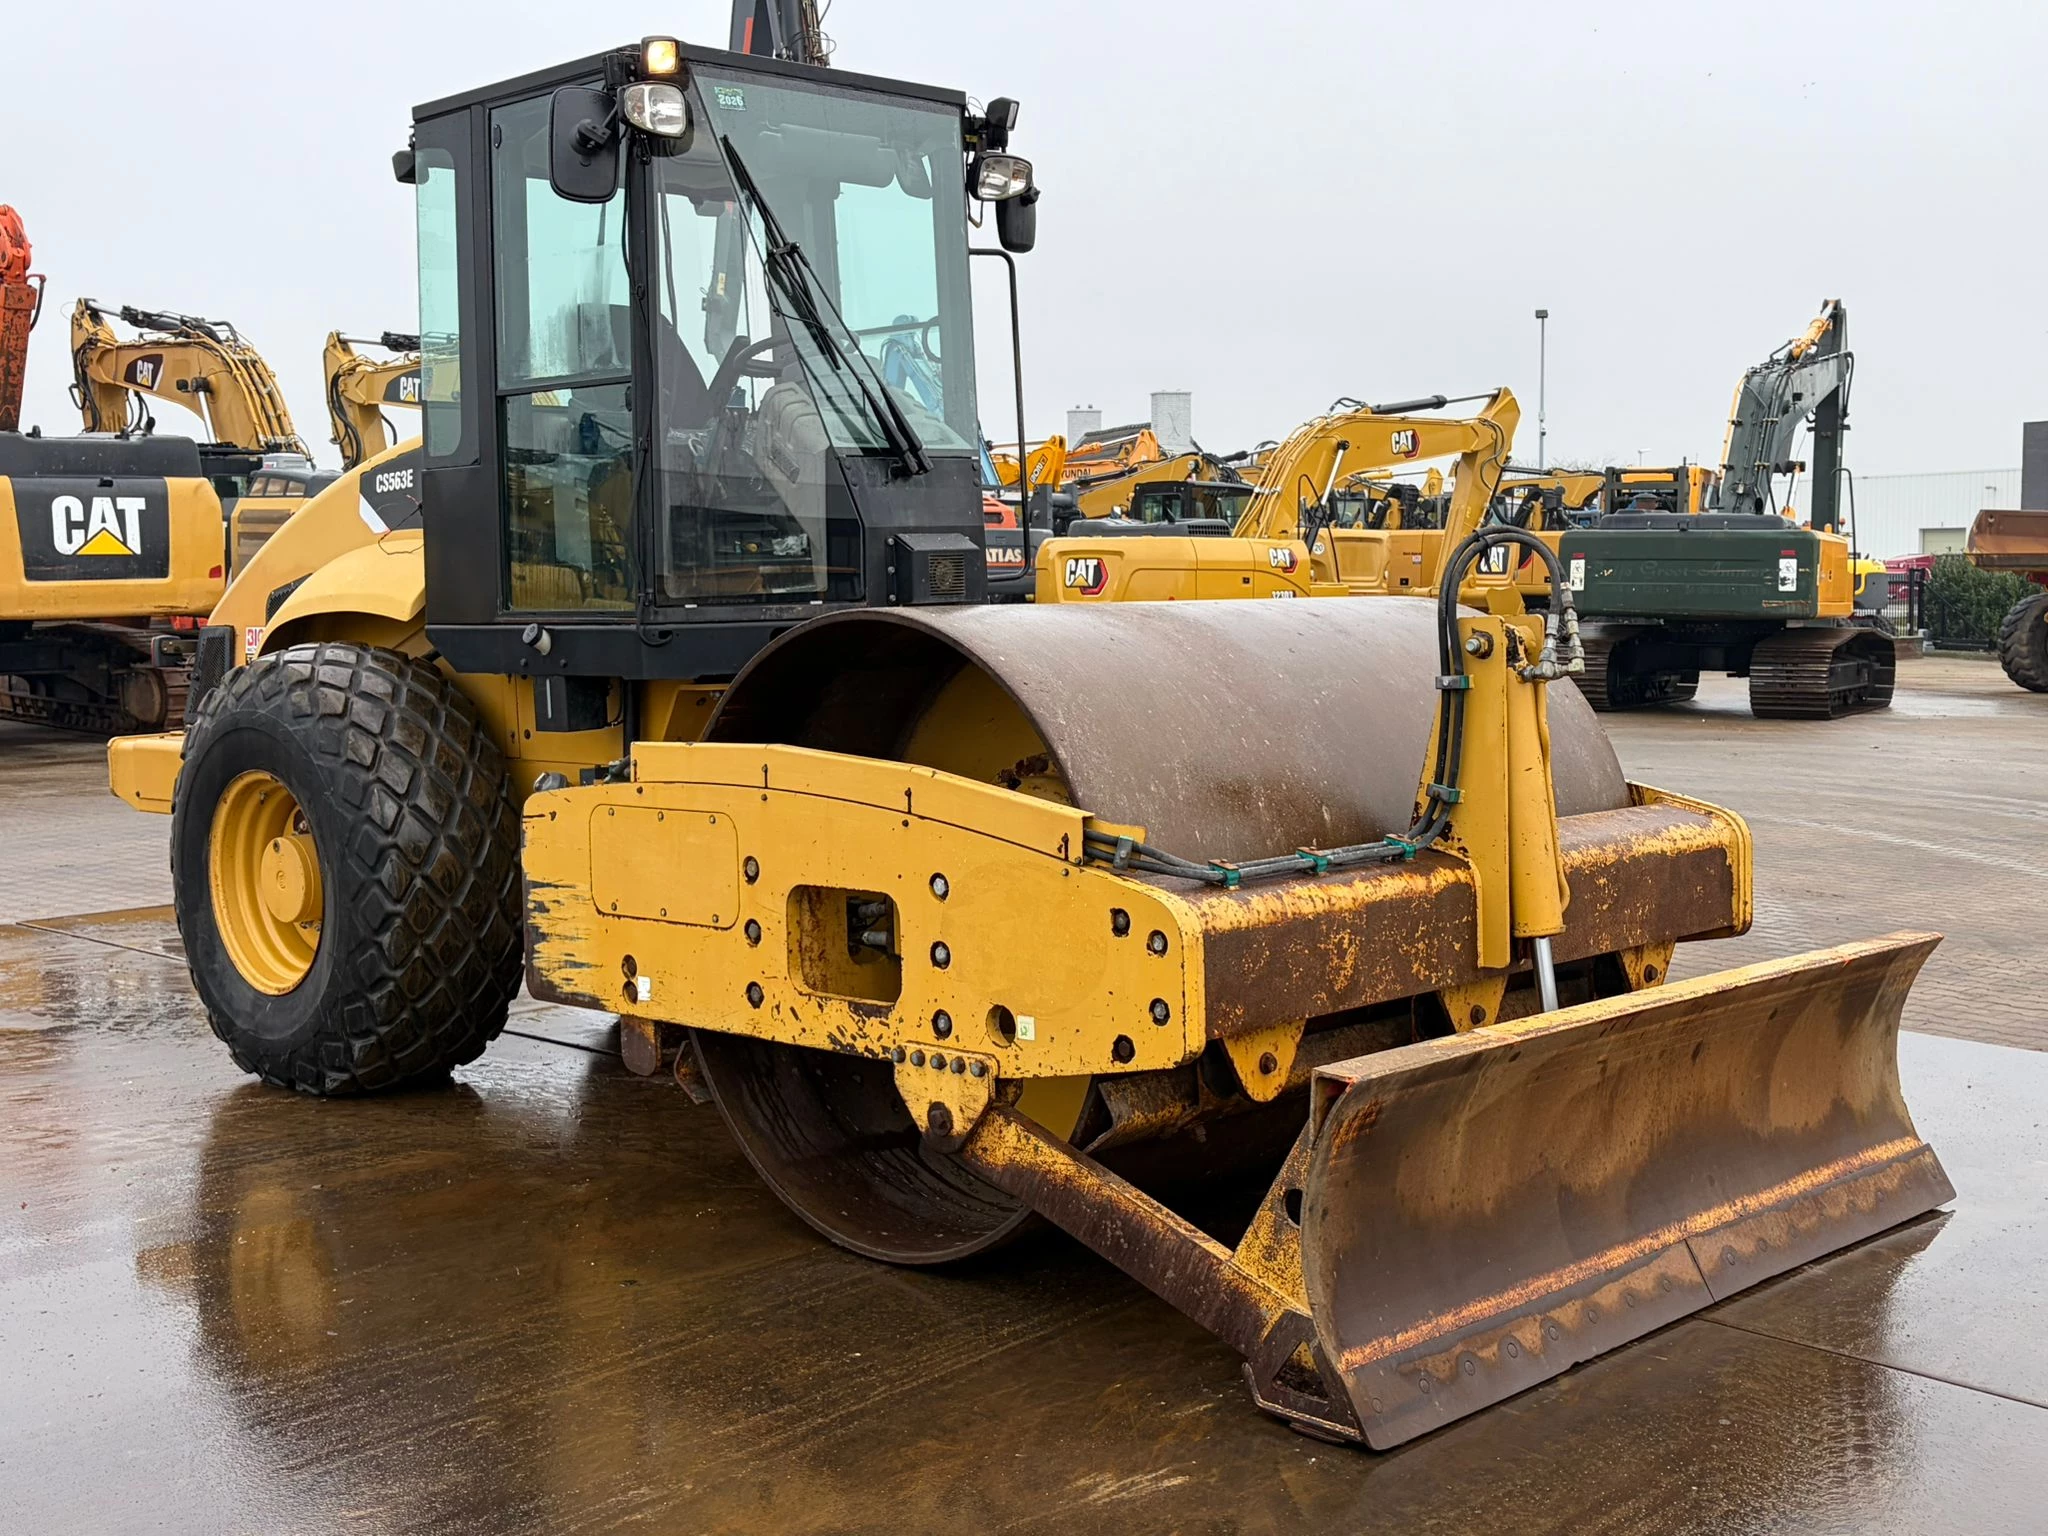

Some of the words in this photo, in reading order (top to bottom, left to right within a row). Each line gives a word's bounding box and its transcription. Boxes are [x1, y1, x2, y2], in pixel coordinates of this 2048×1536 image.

[717, 94, 744, 107] 2026
[136, 359, 154, 387] CAT
[400, 376, 421, 402] CAT
[1391, 430, 1413, 454] CAT
[376, 469, 413, 493] CS563E
[1061, 468, 1091, 479] YUNDAI
[51, 495, 146, 556] CAT
[986, 547, 1023, 563] ATLAS
[1269, 548, 1291, 568] CAT
[1065, 559, 1097, 587] CAT
